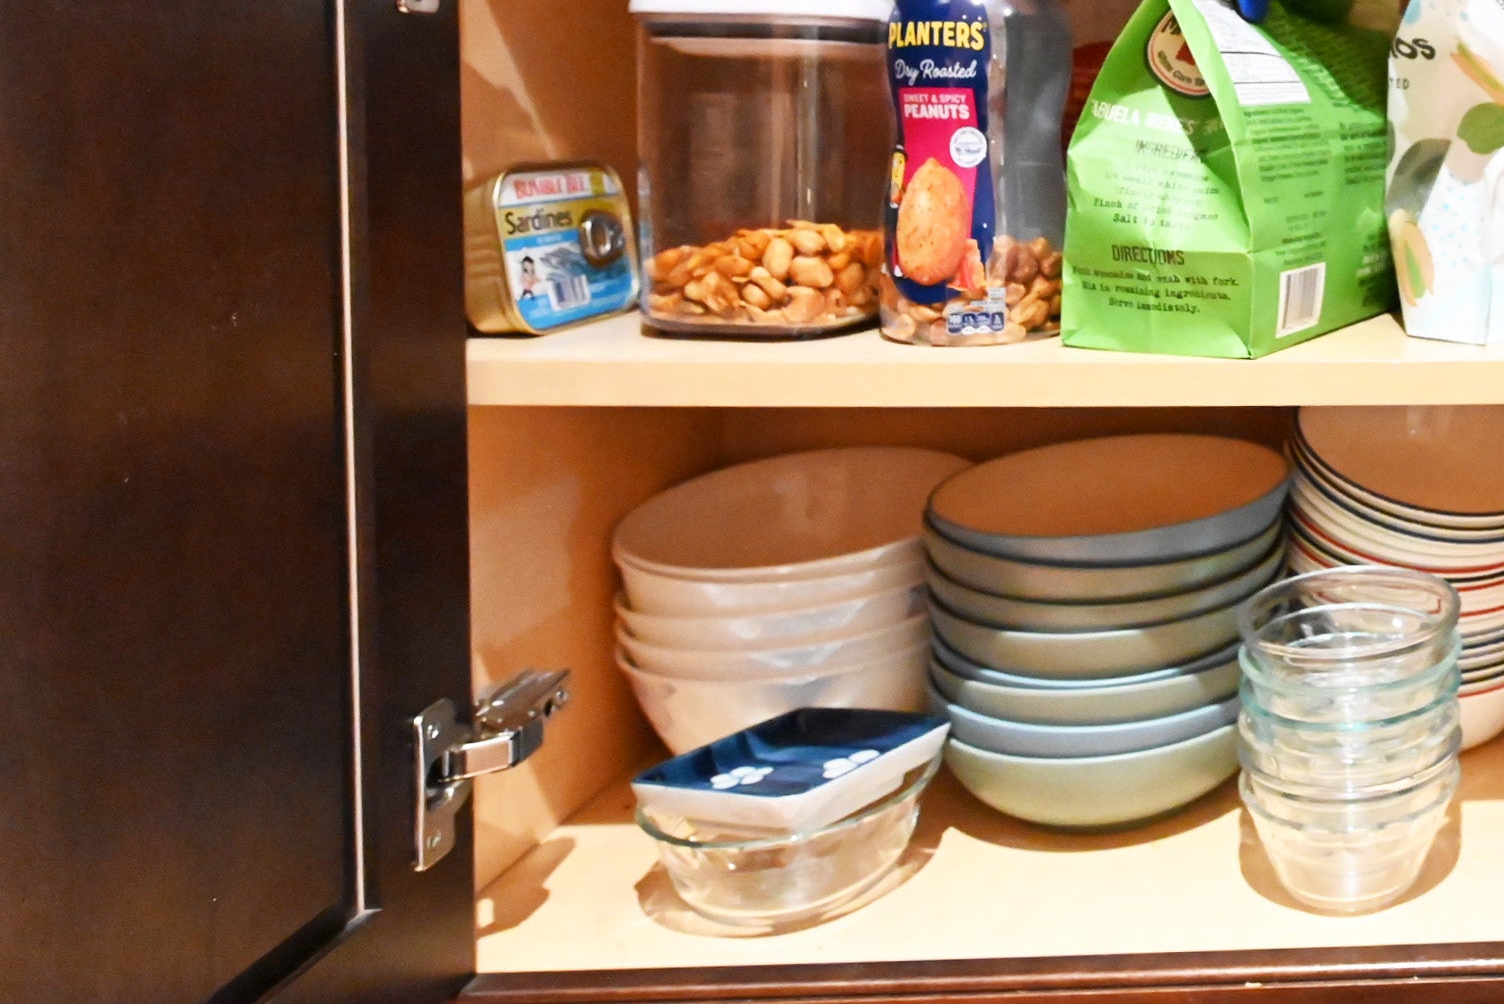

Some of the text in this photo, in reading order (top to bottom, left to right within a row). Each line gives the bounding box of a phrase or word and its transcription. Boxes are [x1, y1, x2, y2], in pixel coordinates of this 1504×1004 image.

[888, 21, 985, 51] PLANTERS
[1392, 37, 1436, 60] OS
[894, 58, 978, 87] Dry Roasted
[939, 94, 966, 103] SPICY
[903, 103, 970, 120] PEANUTS
[505, 208, 573, 235] Sardines
[1112, 213, 1138, 224] Salt
[1111, 244, 1185, 266] DIRECTIONS
[1185, 275, 1208, 286] with
[1212, 276, 1239, 287] fork.
